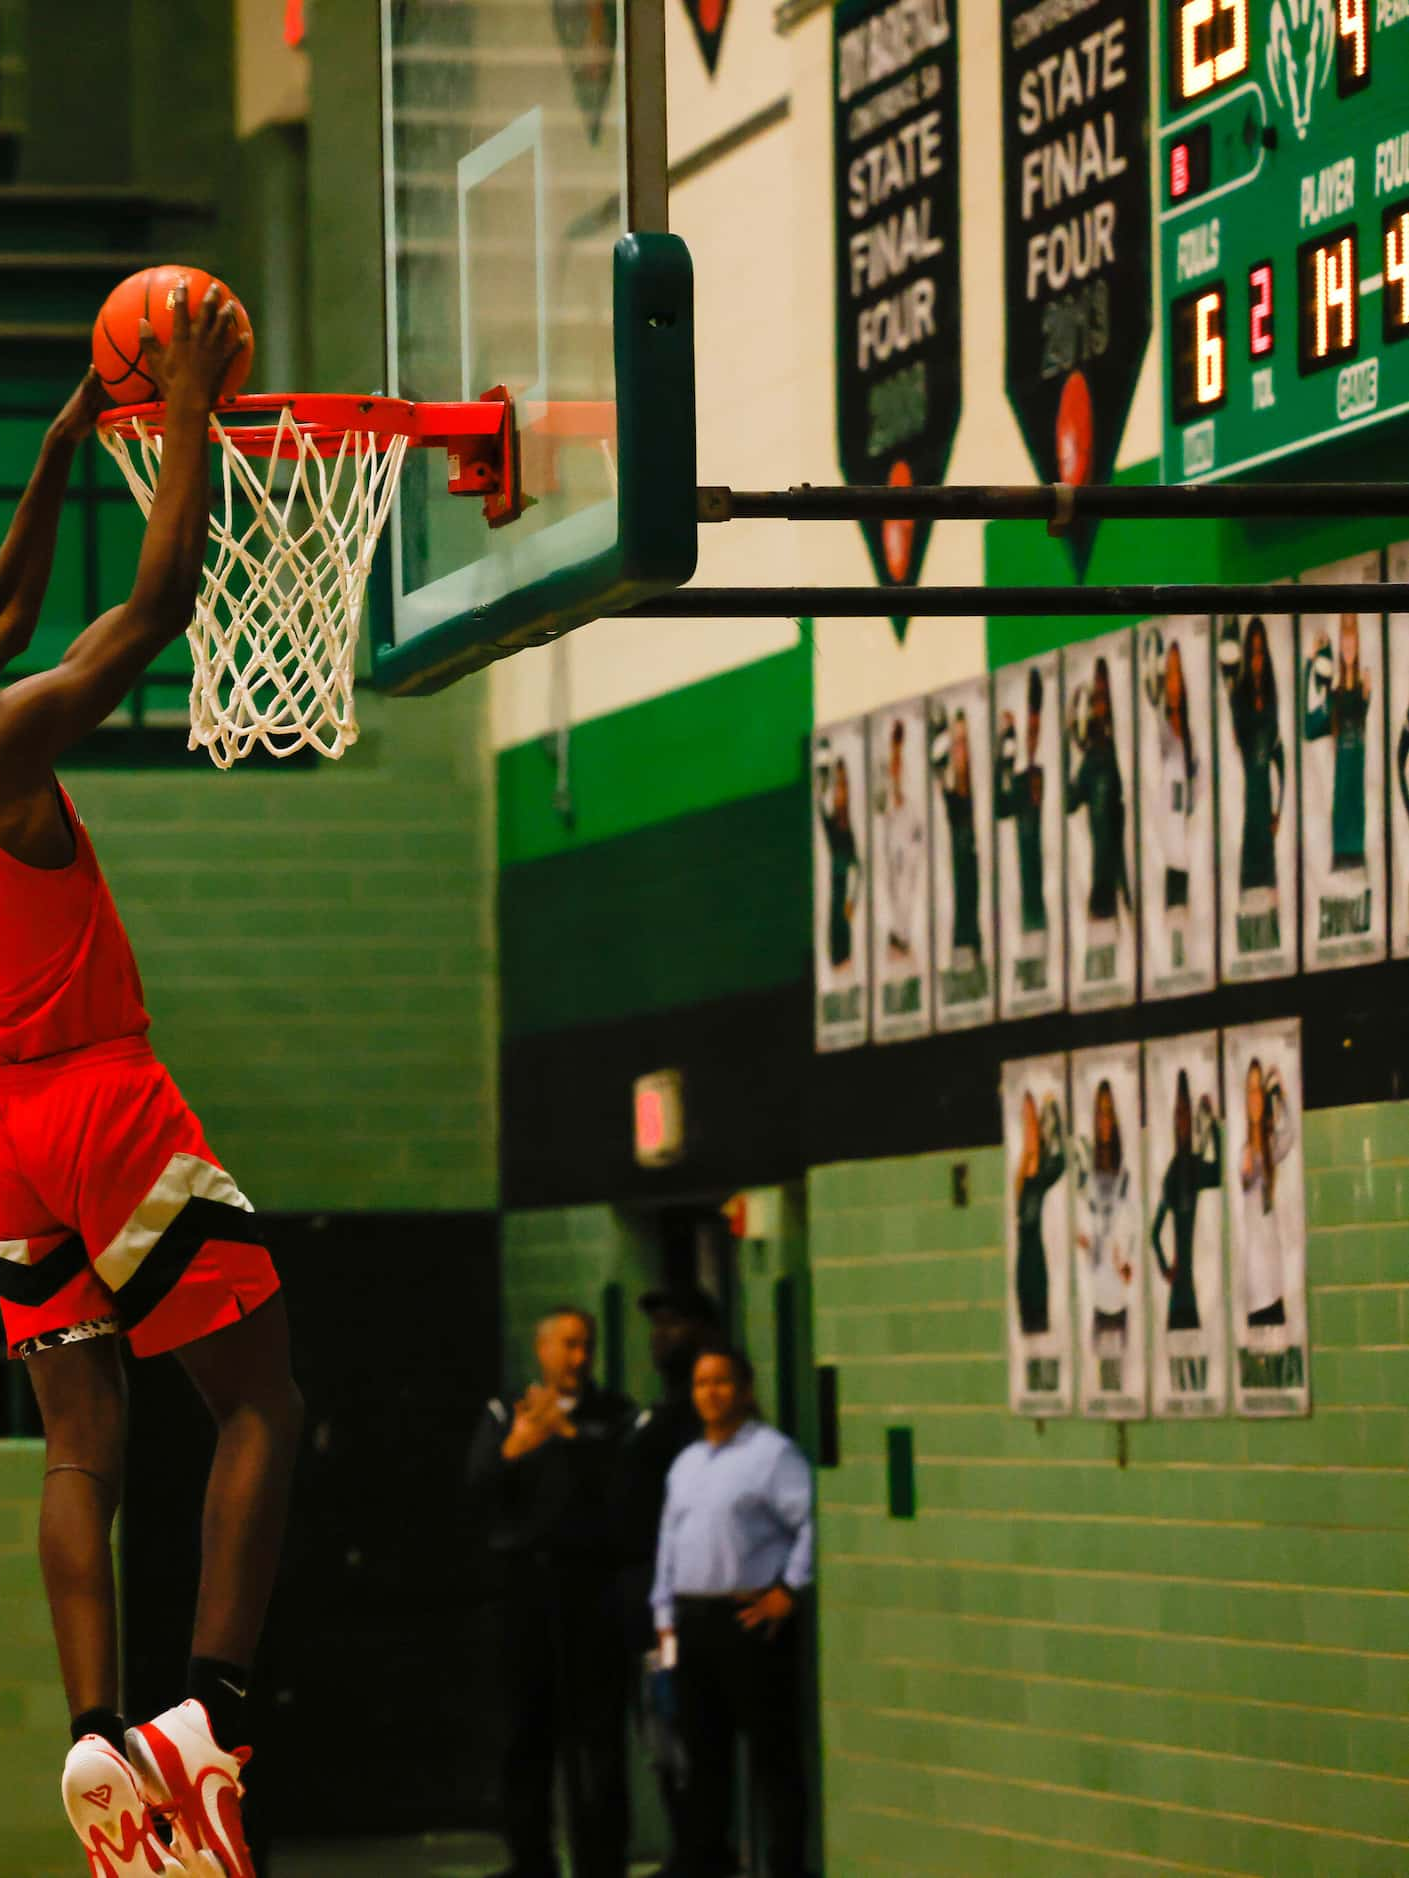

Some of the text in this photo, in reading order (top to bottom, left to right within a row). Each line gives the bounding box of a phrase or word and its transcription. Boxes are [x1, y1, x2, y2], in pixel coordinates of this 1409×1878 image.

[1018, 18, 1128, 136] STATE
[1340, 0, 1366, 77] 4
[848, 110, 942, 219] STATE
[1022, 111, 1128, 220] FINAL
[1299, 156, 1355, 229] PLAYER
[849, 198, 943, 297] FINAL
[1027, 201, 1116, 301] FOUR
[857, 277, 936, 371] FOUR
[1250, 266, 1273, 354] 2
[1314, 238, 1352, 358] 14
[1196, 292, 1223, 404] 6
[1339, 358, 1377, 419] GAME
